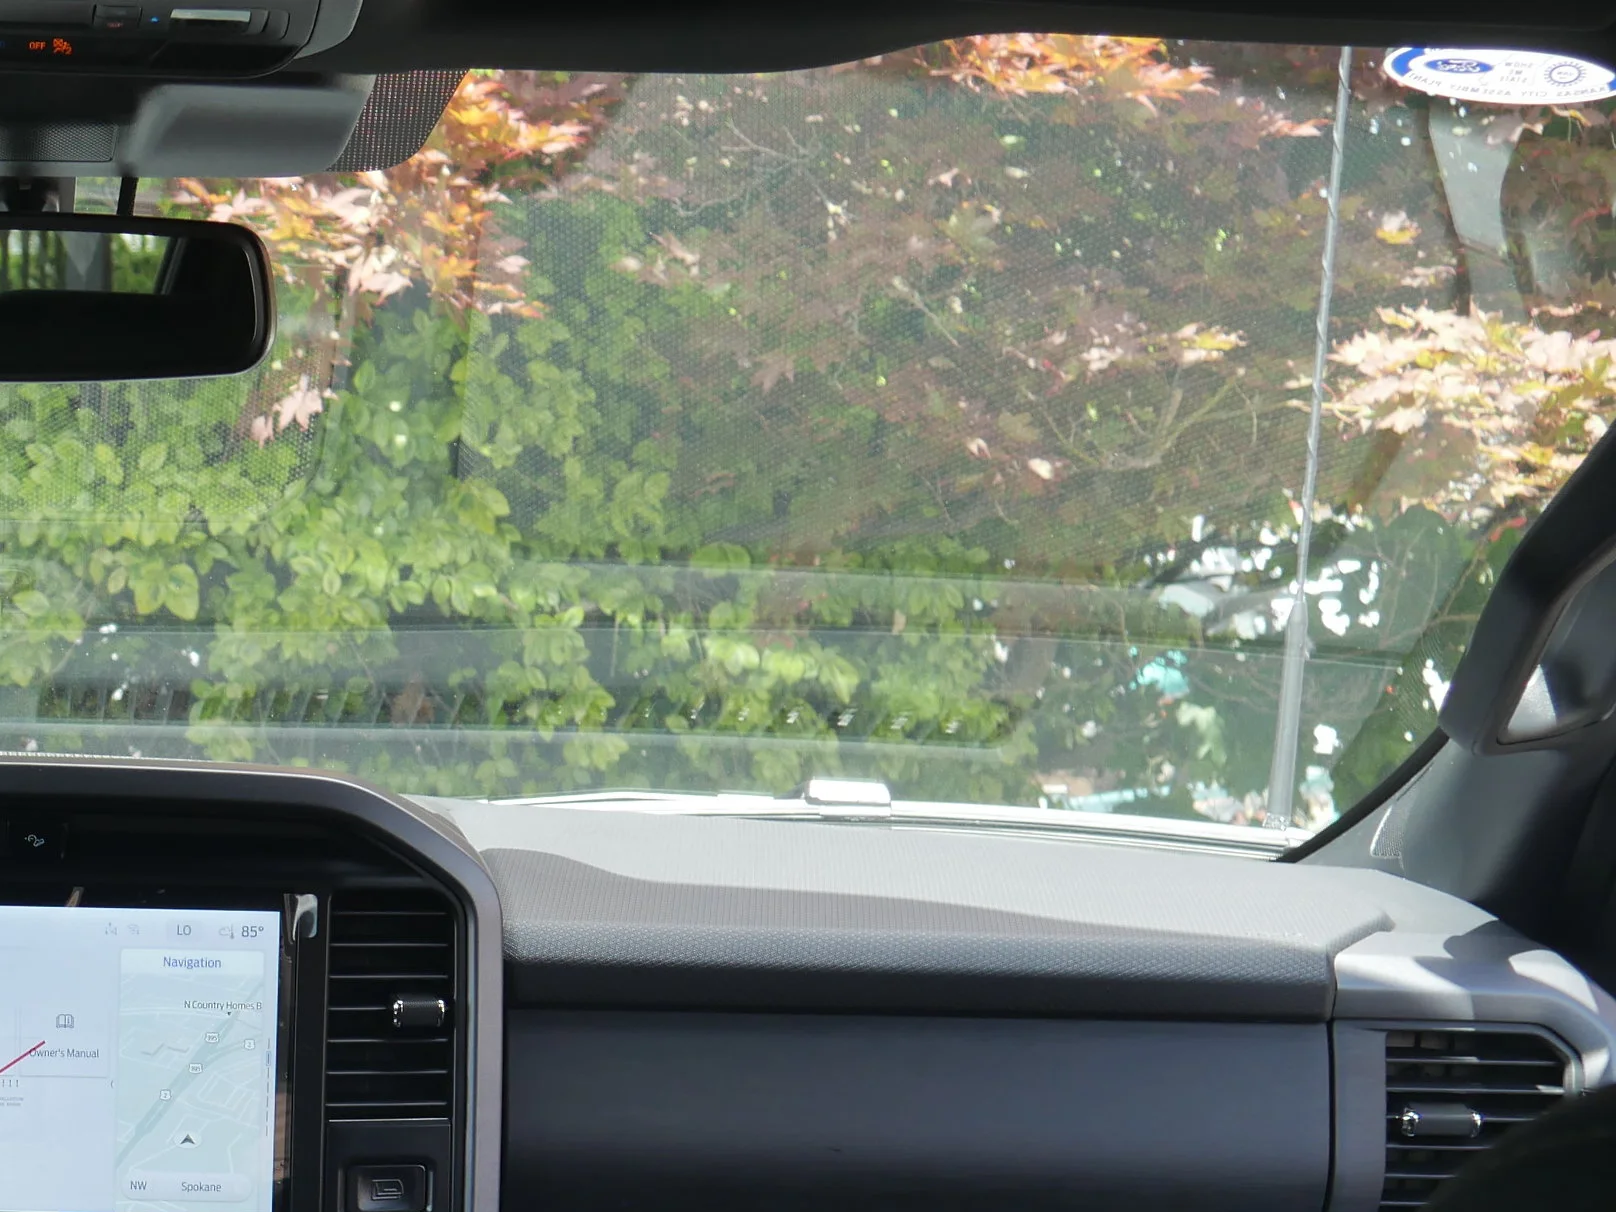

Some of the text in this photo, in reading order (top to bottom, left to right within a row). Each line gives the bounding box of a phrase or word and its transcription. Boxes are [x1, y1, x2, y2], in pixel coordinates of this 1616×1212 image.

[29, 41, 46, 50] OFF
[176, 924, 264, 938] LO 85°
[163, 956, 222, 969] Navigation
[184, 1001, 191, 1009] N
[192, 1001, 224, 1011] Country
[226, 1001, 255, 1010] Homes
[29, 1048, 99, 1059] Owner's Manual
[130, 1181, 222, 1193] NW Spokane
